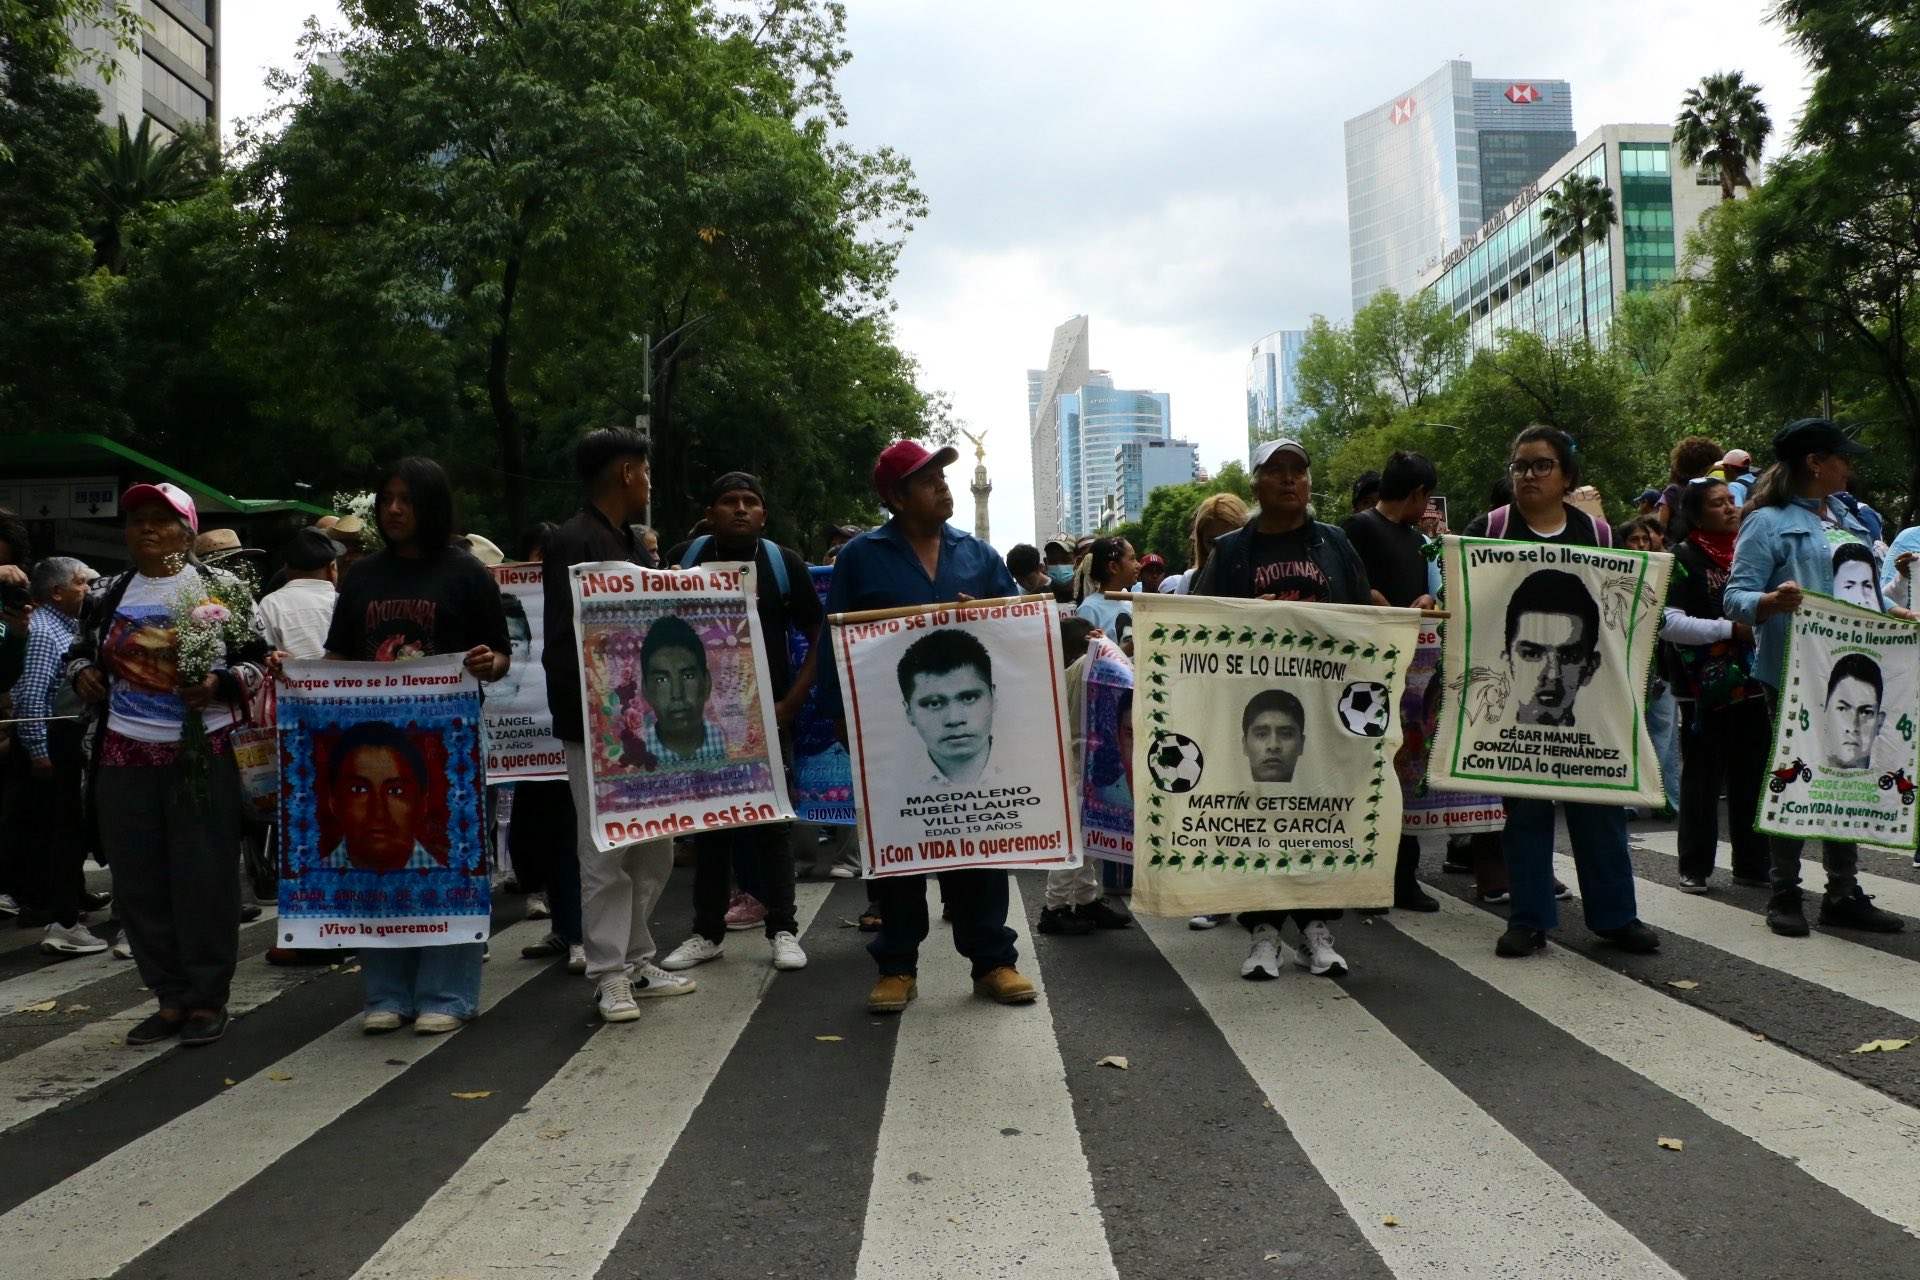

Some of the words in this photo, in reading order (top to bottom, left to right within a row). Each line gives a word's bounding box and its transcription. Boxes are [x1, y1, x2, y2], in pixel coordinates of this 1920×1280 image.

[1442, 231, 1478, 272] SHERATON
[1512, 181, 1539, 214] ISABEL
[1471, 549, 1514, 567] ¡Vivo
[1519, 550, 1538, 562] se
[1541, 546, 1556, 563] lo
[1561, 548, 1635, 573] llevaron!
[582, 573, 634, 597] ¡Nos
[710, 572, 740, 591] 43!
[850, 620, 899, 644] ¡Vivo
[906, 615, 926, 630] se
[932, 610, 950, 626] lo
[956, 603, 1040, 623] llevaron!
[1802, 622, 1833, 637] ¡Vivo
[1836, 630, 1848, 641] se
[1851, 630, 1862, 644] lo
[1865, 632, 1918, 645] llevaron!
[1180, 653, 1218, 674] ¡VIVO
[1226, 654, 1243, 674] SE
[1250, 655, 1269, 676] LO
[1274, 656, 1347, 681] LLEVARON!
[334, 677, 362, 687] vivo
[368, 678, 380, 687] se
[385, 676, 397, 686] lo
[402, 674, 463, 686] llevaron!
[1499, 726, 1542, 742] CÉSAR
[1544, 732, 1596, 745] MANUEL
[487, 754, 498, 769] lo
[502, 750, 566, 771] queremos!
[1474, 740, 1541, 756] GONZÁLEZ
[1543, 743, 1620, 760] HERNÁNDEZ
[1462, 754, 1494, 770] ¡Con
[1497, 756, 1533, 772] VIDA
[1536, 757, 1549, 773] lo
[1551, 763, 1628, 778] queremos!
[906, 786, 1032, 805] MAGDALENO
[1188, 791, 1251, 809] MARTÍN
[1256, 796, 1355, 812] GETSEMANY
[900, 803, 967, 817] RUBÉN
[973, 796, 1041, 811] LAURO
[1781, 801, 1808, 814] ¡Con
[1810, 803, 1832, 815] VIDA
[1834, 804, 1843, 815] lo
[1846, 807, 1898, 821] queremos!
[605, 813, 695, 842] Dónde
[703, 802, 775, 826] están
[923, 810, 1019, 827] VILLEGAS
[1182, 811, 1267, 833] SÁNCHEZ
[1274, 813, 1346, 834] GARCÍA
[1426, 811, 1438, 824] lo
[925, 827, 961, 837] EDAD
[967, 825, 981, 834] 19
[985, 821, 1023, 832] AÑOS
[881, 845, 914, 867] ¡Con
[918, 839, 957, 860] VIDA
[961, 838, 975, 857] lo
[979, 831, 1061, 858] queremos!
[1087, 830, 1117, 849] ¡Vivo
[1121, 836, 1133, 851] lo
[1171, 832, 1207, 847] ¡Con
[1215, 836, 1251, 848] VIDA
[1258, 837, 1270, 848] lo
[1278, 837, 1354, 850] queremos!
[320, 924, 355, 937] ¡Vivo
[360, 924, 374, 935] lo
[377, 922, 448, 937] queremos!
